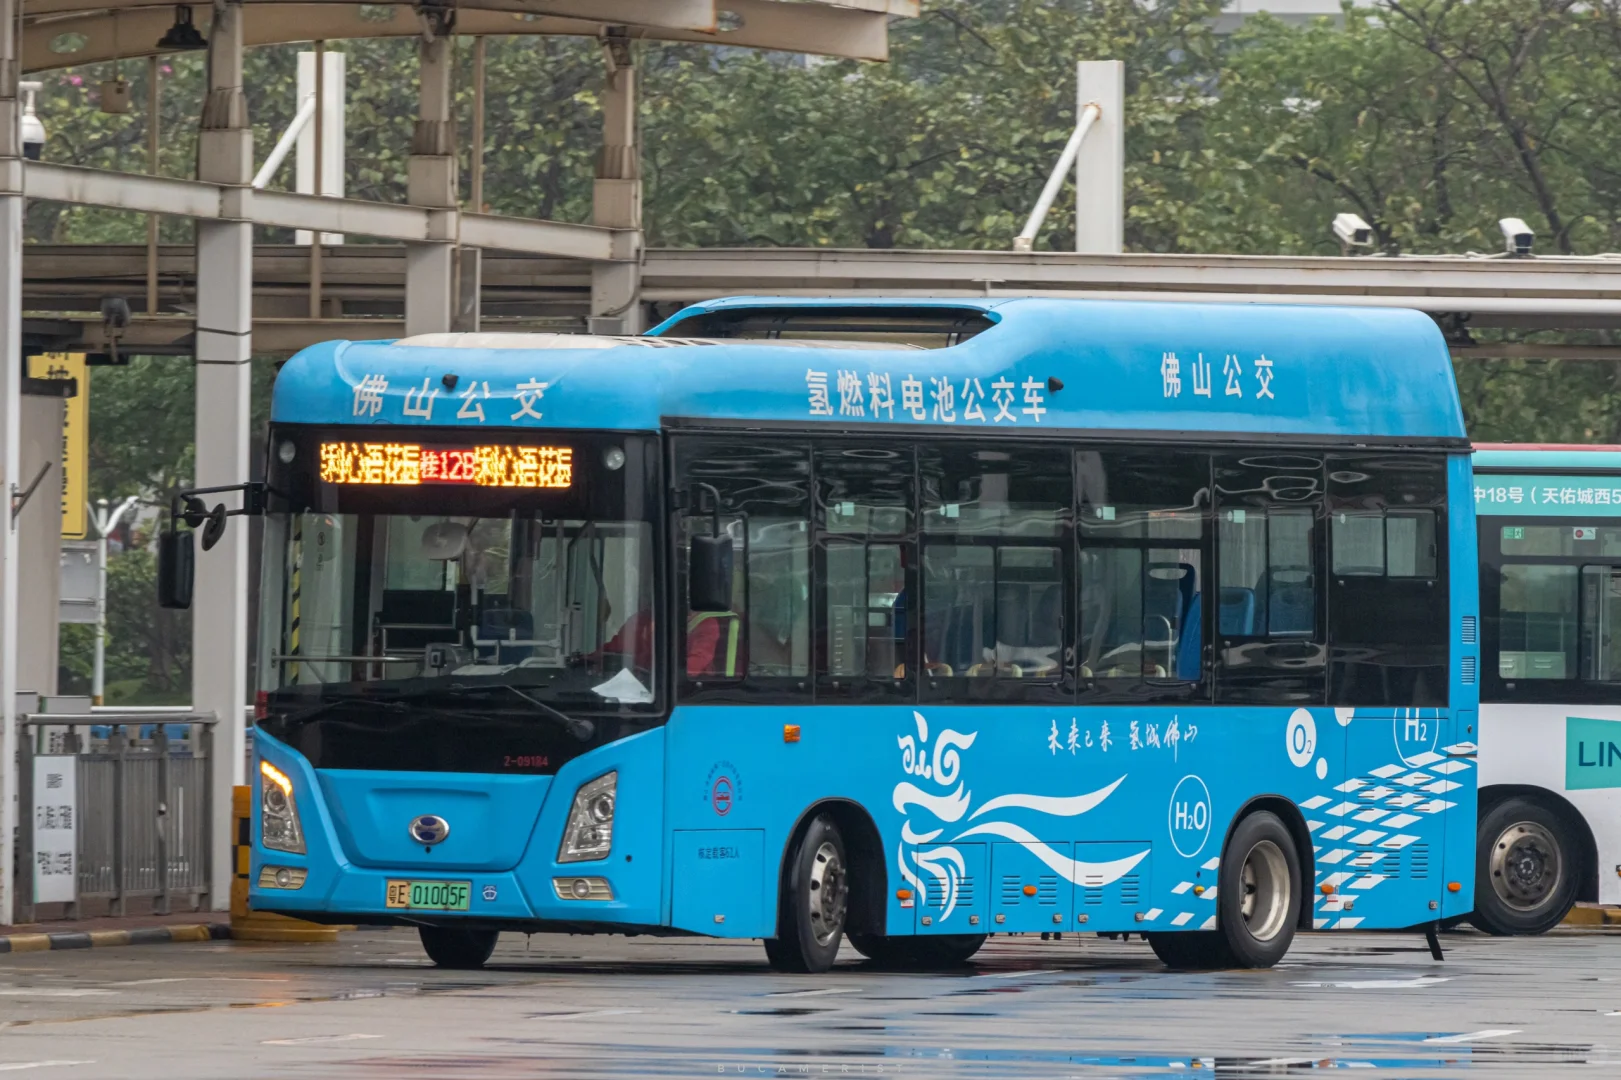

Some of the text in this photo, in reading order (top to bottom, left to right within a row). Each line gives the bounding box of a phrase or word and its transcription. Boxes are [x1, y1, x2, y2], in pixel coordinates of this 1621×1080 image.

[352, 373, 549, 423] 佛山公交
[805, 368, 1046, 423] 氢燃料电池公交车
[1160, 352, 1275, 400] 佛山公交
[421, 450, 474, 481] 桂12B
